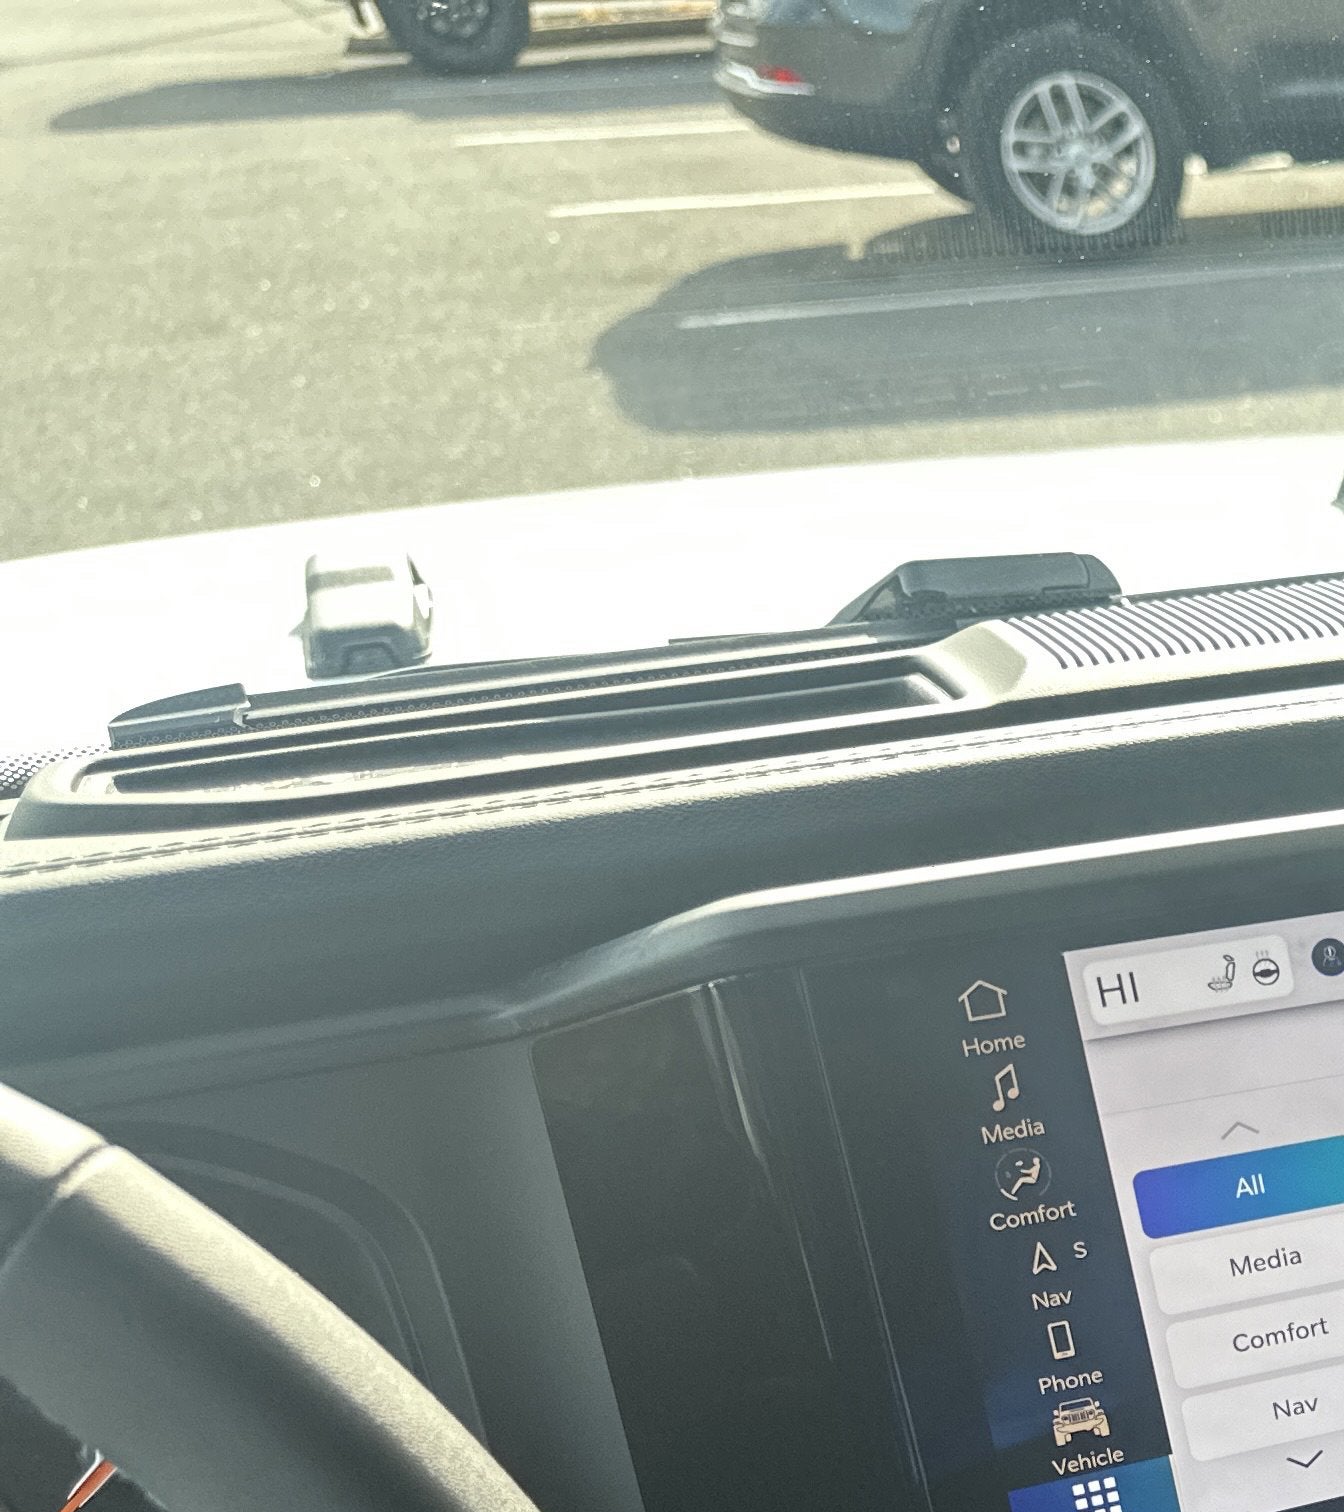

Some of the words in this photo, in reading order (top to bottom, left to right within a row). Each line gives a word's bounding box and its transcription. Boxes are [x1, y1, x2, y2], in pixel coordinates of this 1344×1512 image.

[1096, 971, 1140, 1008] HI
[961, 1030, 1027, 1058] Home
[981, 1118, 1046, 1146] Media
[1235, 1173, 1266, 1199] All
[989, 1201, 1077, 1231] Comfort
[1073, 1242, 1088, 1259] S
[1229, 1247, 1303, 1278] Media
[1031, 1287, 1073, 1311] Nav
[1231, 1316, 1330, 1353] Comfort
[1038, 1367, 1104, 1395] Phone
[1272, 1395, 1319, 1420] Nav
[1051, 1445, 1125, 1475] Vehicle
